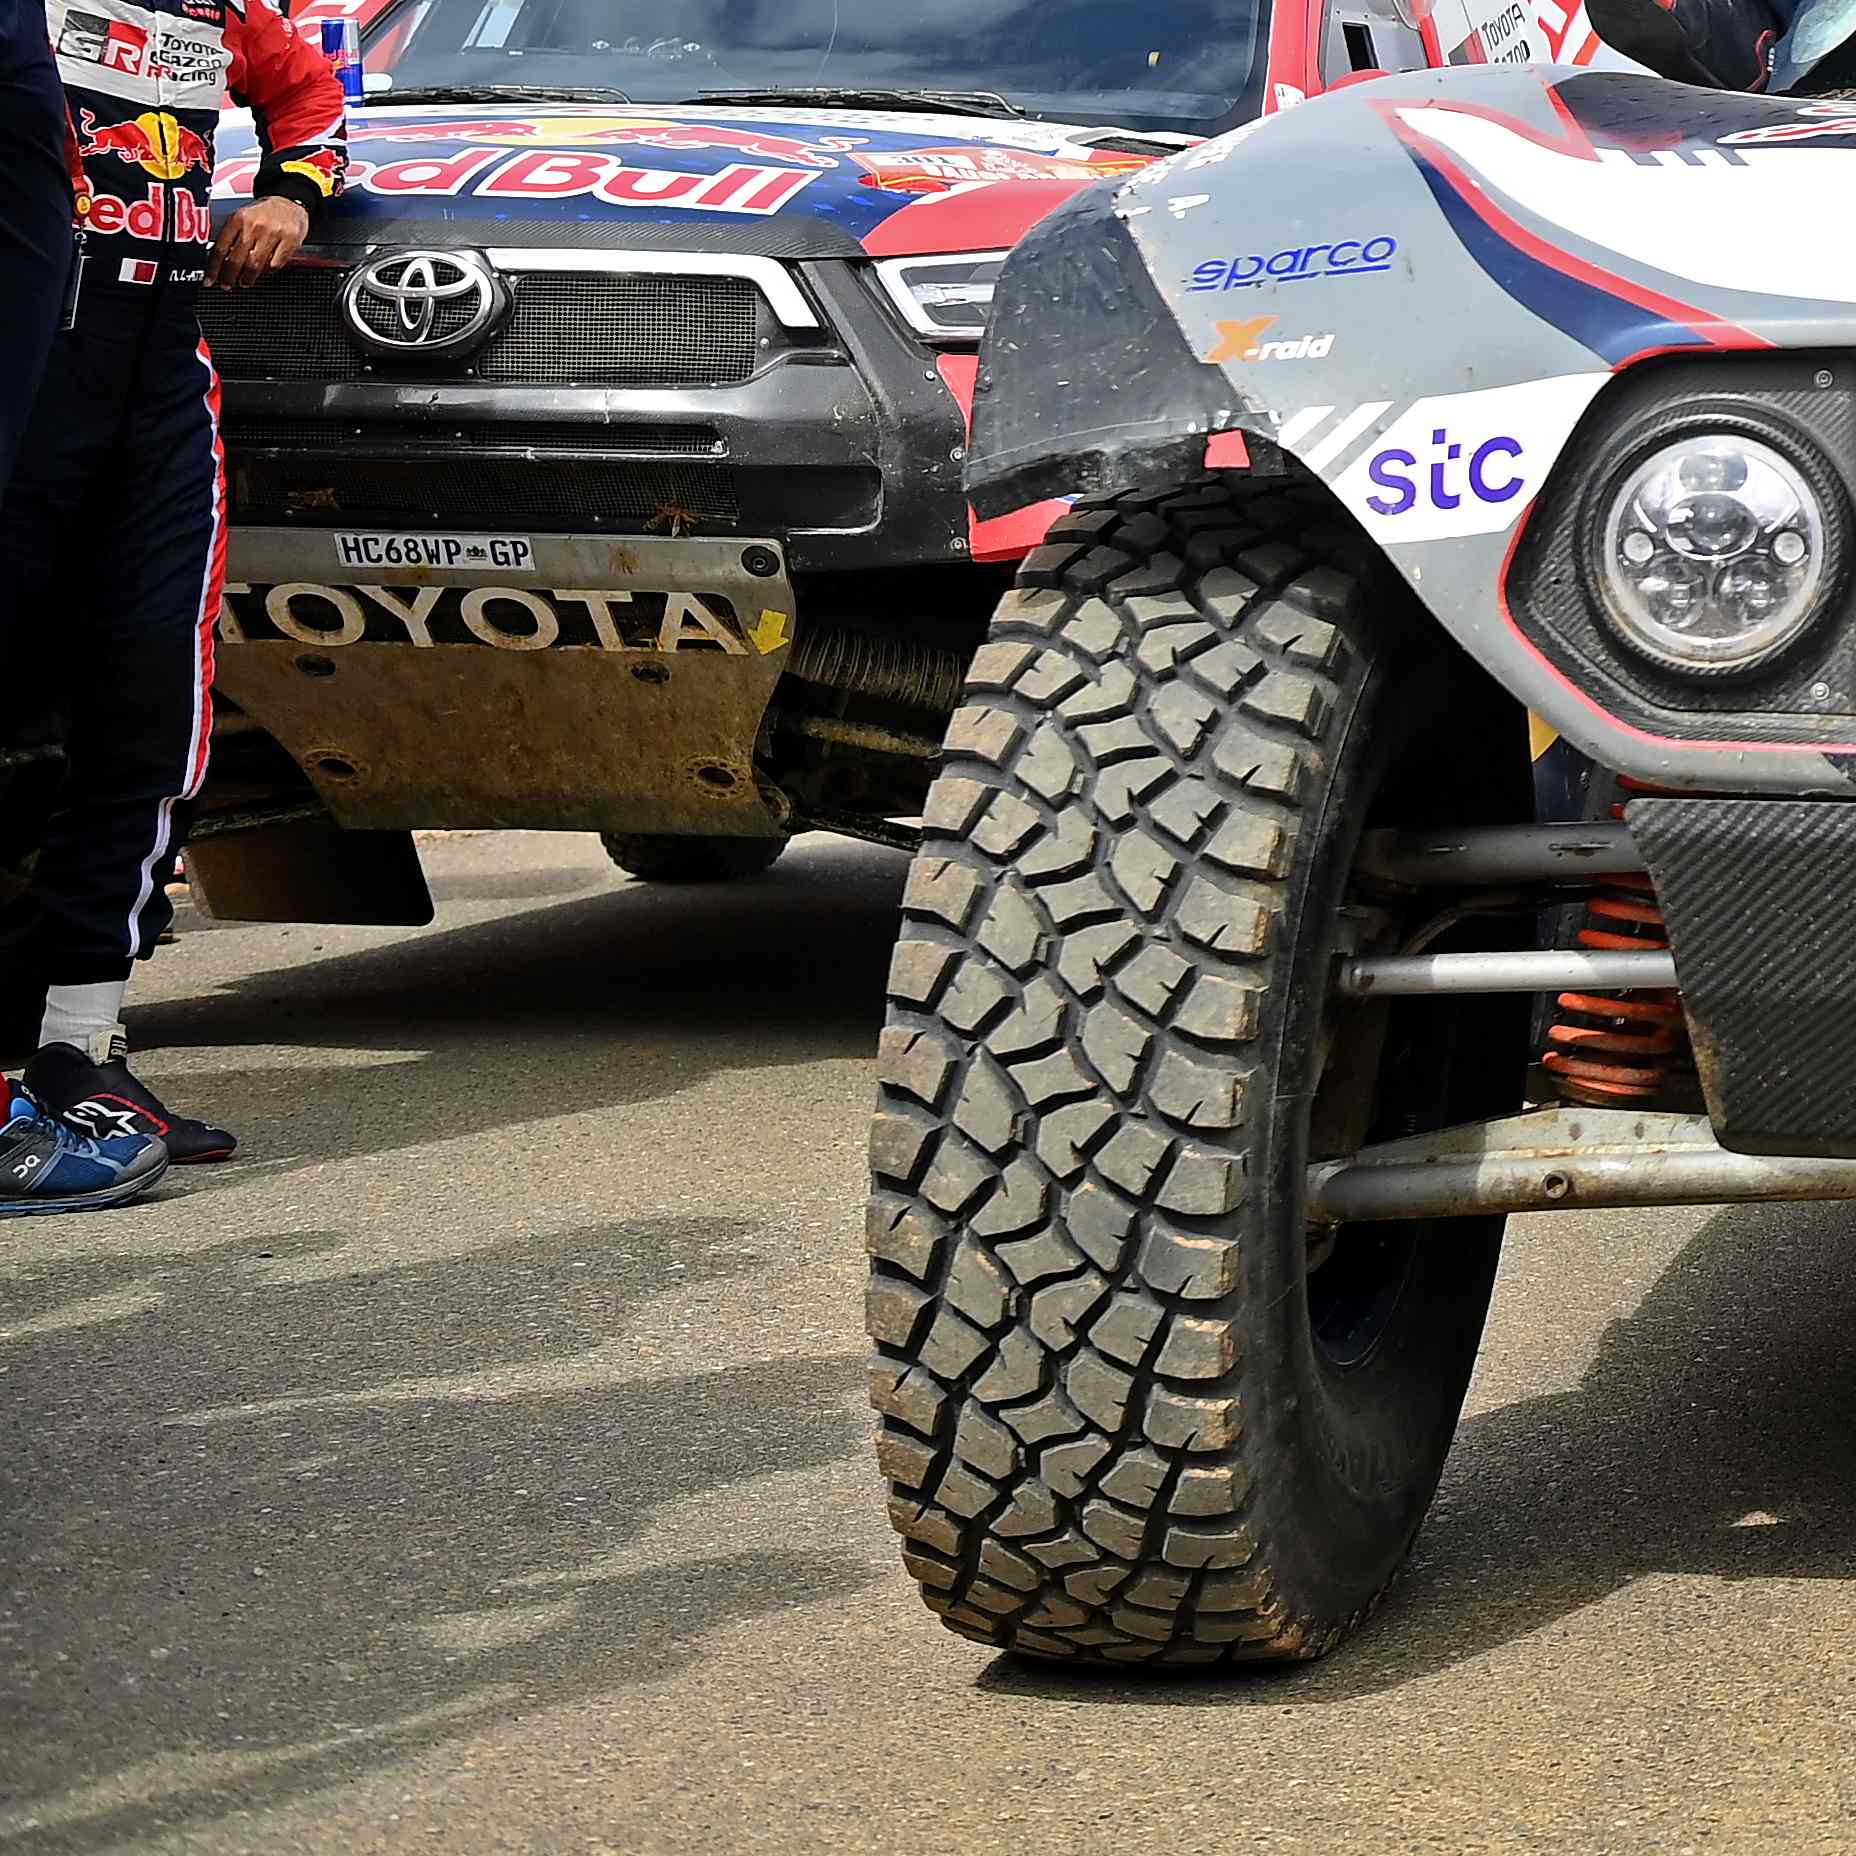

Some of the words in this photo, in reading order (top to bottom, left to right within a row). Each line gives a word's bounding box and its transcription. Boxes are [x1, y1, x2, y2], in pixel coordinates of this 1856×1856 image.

[1481, 2, 1526, 51] TOYOTA
[480, 149, 819, 215] Bull
[74, 182, 165, 242] ed
[1189, 234, 1398, 290] sparco
[1366, 427, 1525, 514] stc
[343, 536, 462, 565] HC68WP
[490, 540, 529, 567] GP
